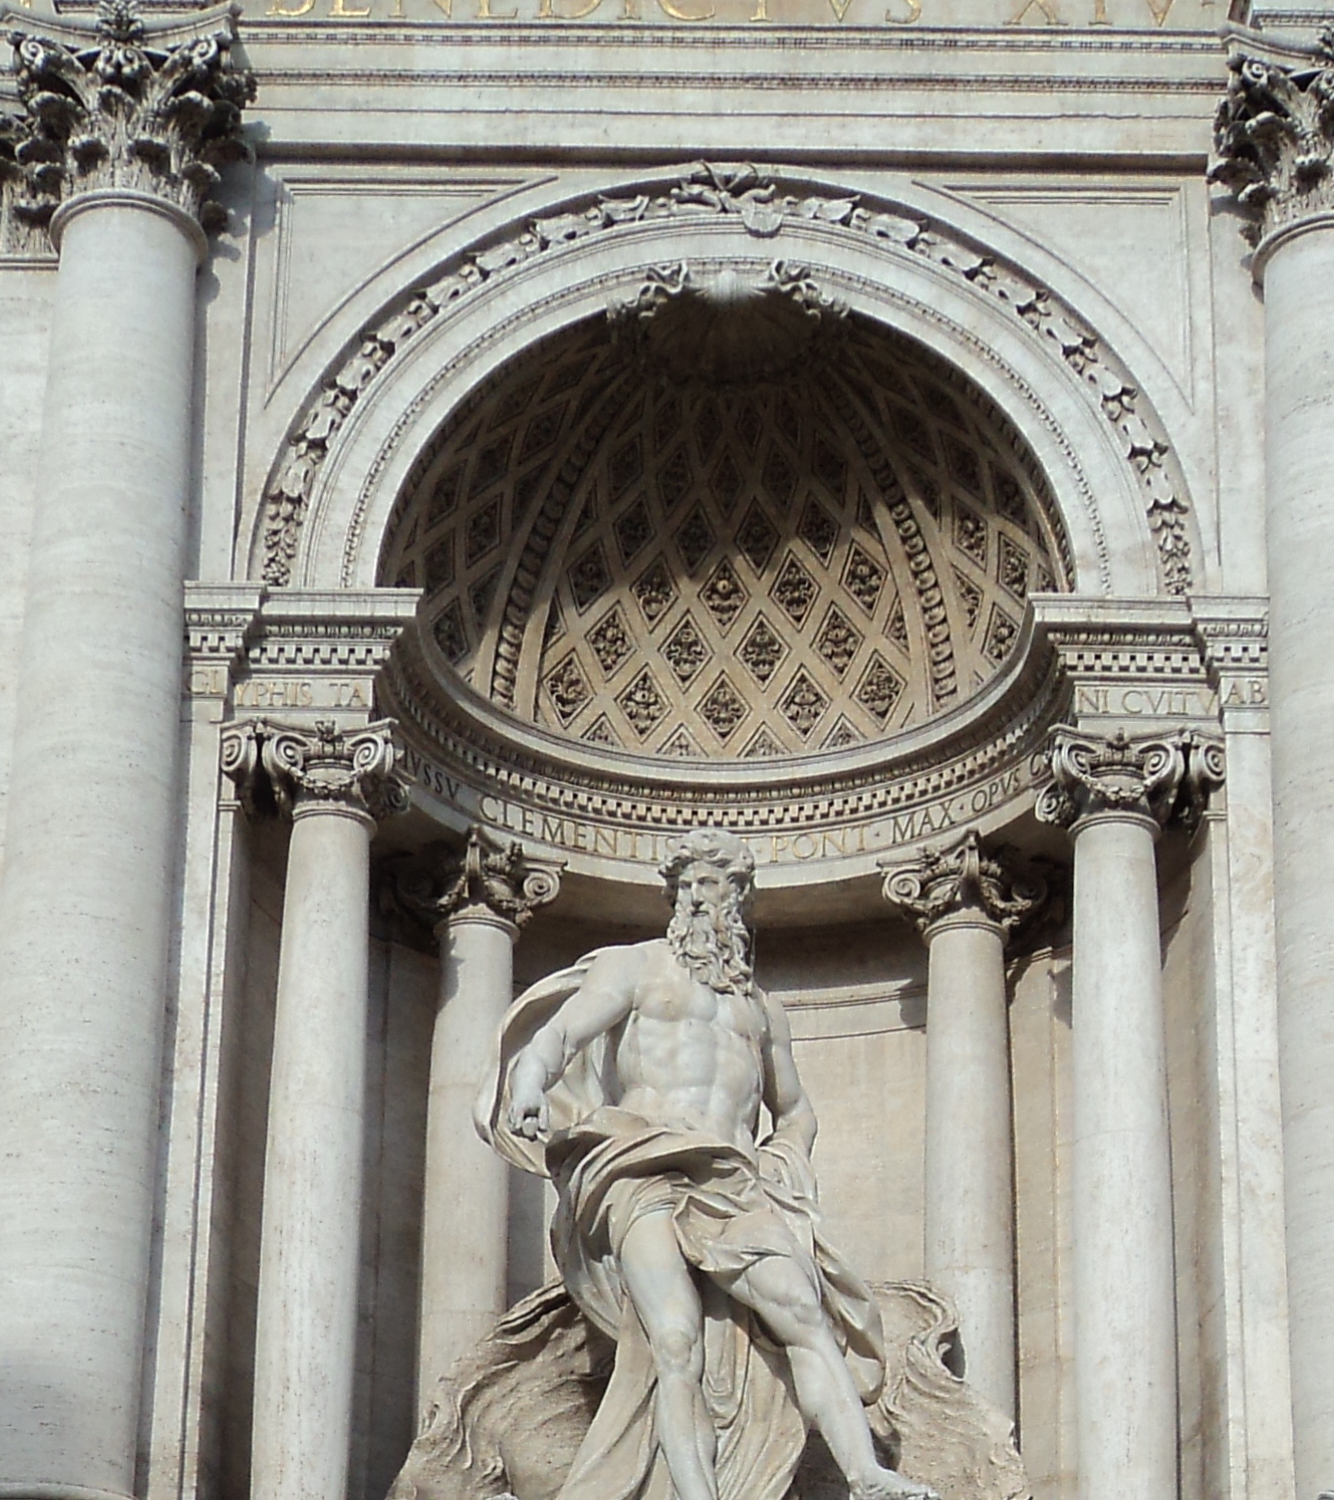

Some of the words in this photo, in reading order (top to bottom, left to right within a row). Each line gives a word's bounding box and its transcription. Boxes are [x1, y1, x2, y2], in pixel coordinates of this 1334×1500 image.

[328, 683, 368, 708] TA
[1077, 689, 1110, 714] NI
[1224, 680, 1267, 705] AB
[478, 794, 671, 862] CLEMENTI
[970, 768, 1021, 814] OPVS
